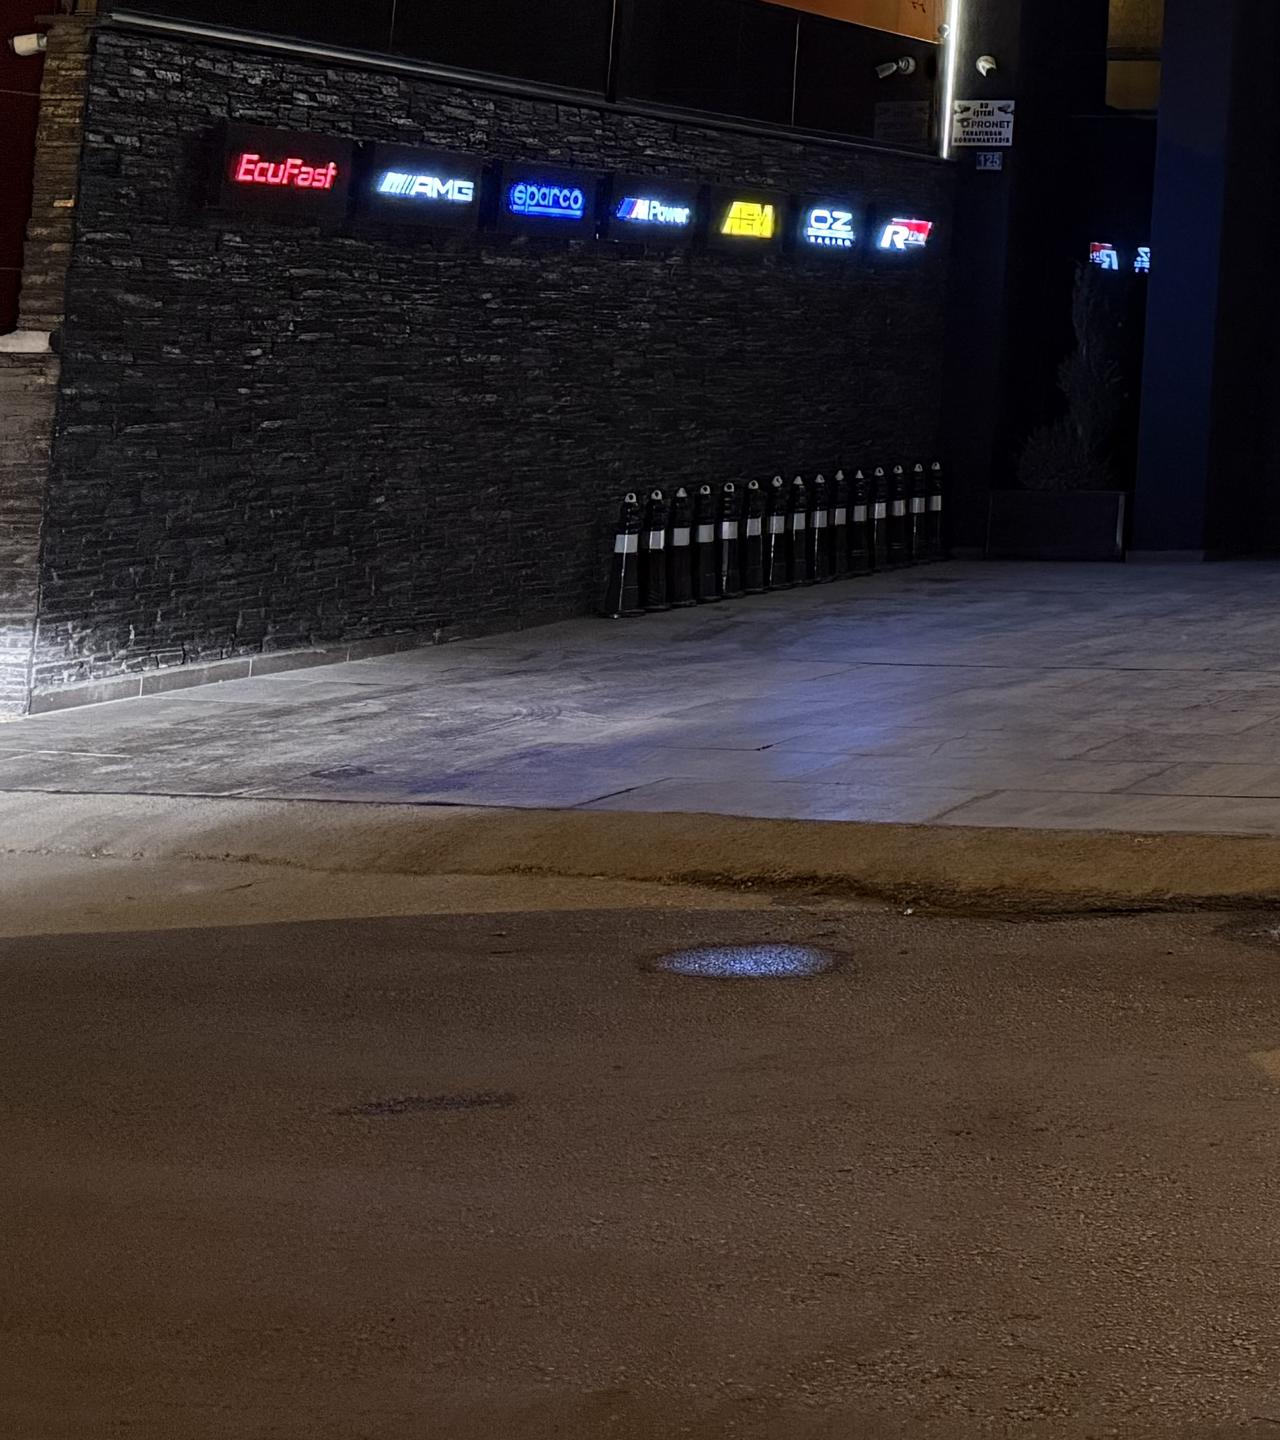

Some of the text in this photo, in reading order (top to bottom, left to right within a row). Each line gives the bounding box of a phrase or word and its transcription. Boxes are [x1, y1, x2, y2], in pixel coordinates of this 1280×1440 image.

[237, 153, 338, 189] EcuFast
[513, 182, 584, 213] sparco
[810, 208, 853, 231] OZ
